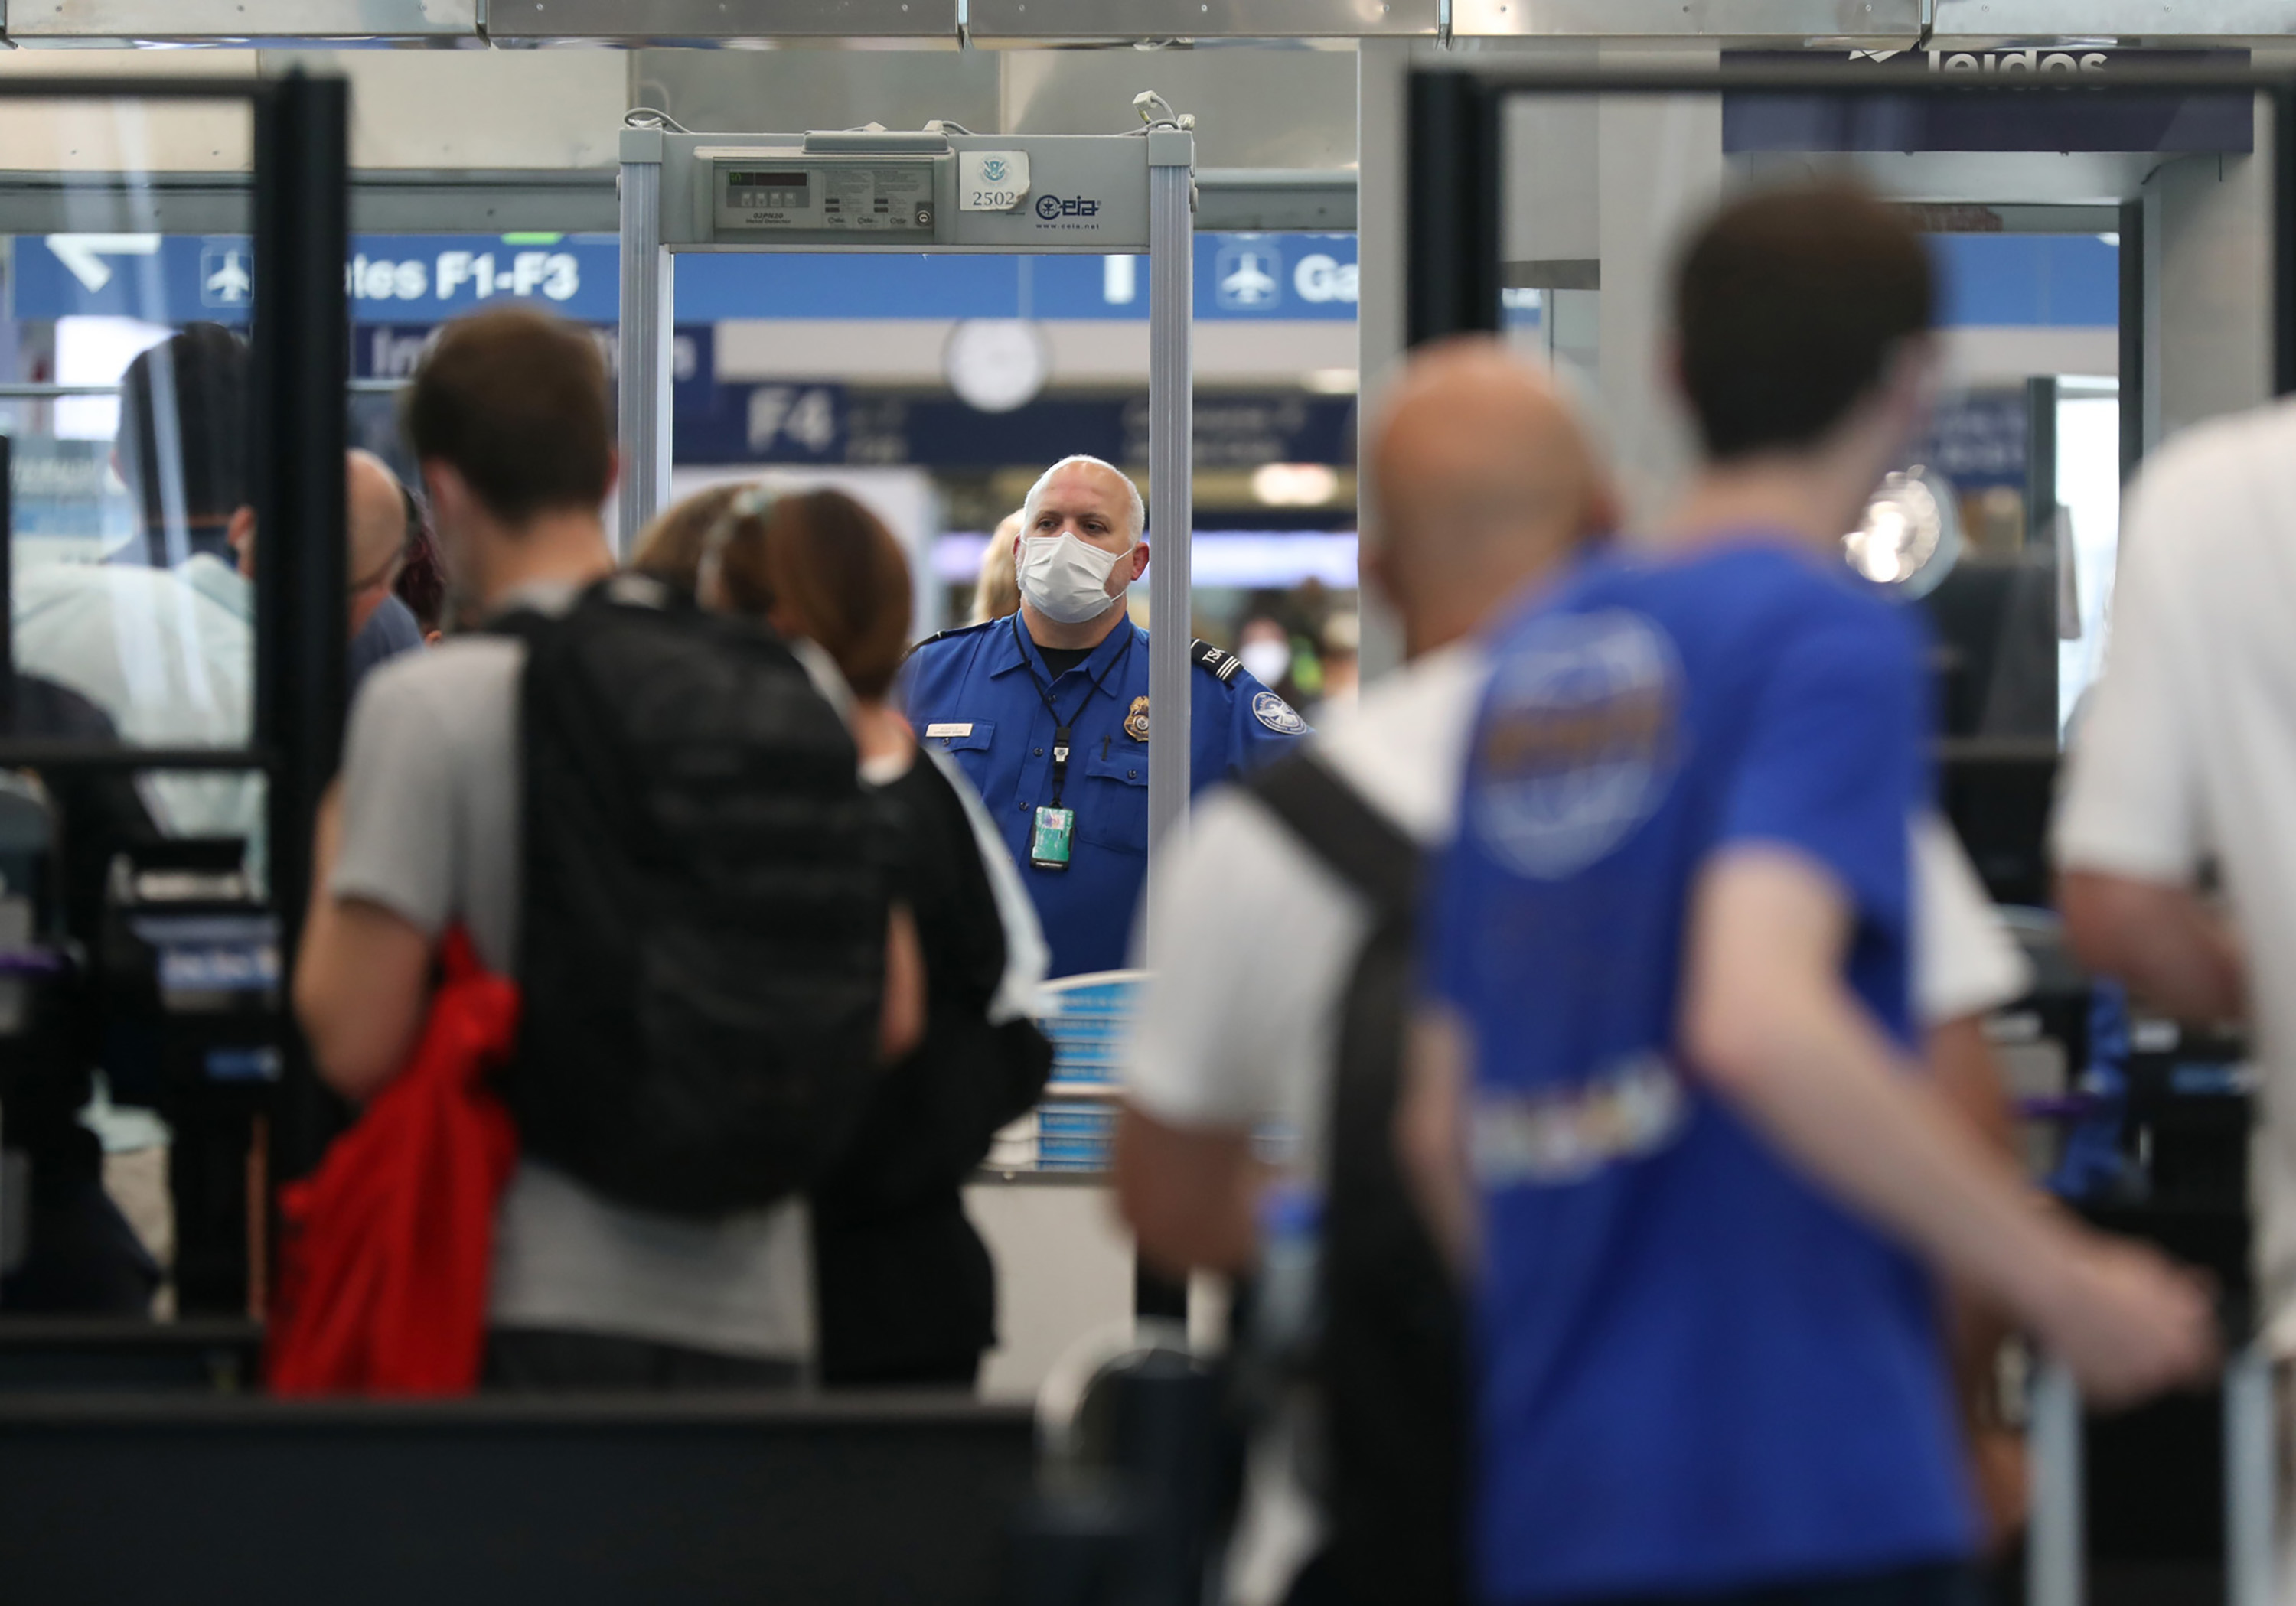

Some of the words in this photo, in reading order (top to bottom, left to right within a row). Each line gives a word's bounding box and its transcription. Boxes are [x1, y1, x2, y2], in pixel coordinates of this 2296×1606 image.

[972, 191, 1015, 206] 2502
[345, 253, 428, 301] tes
[436, 251, 579, 301] F1-F3
[748, 385, 834, 453] F4
[1202, 647, 1225, 663] TSA
